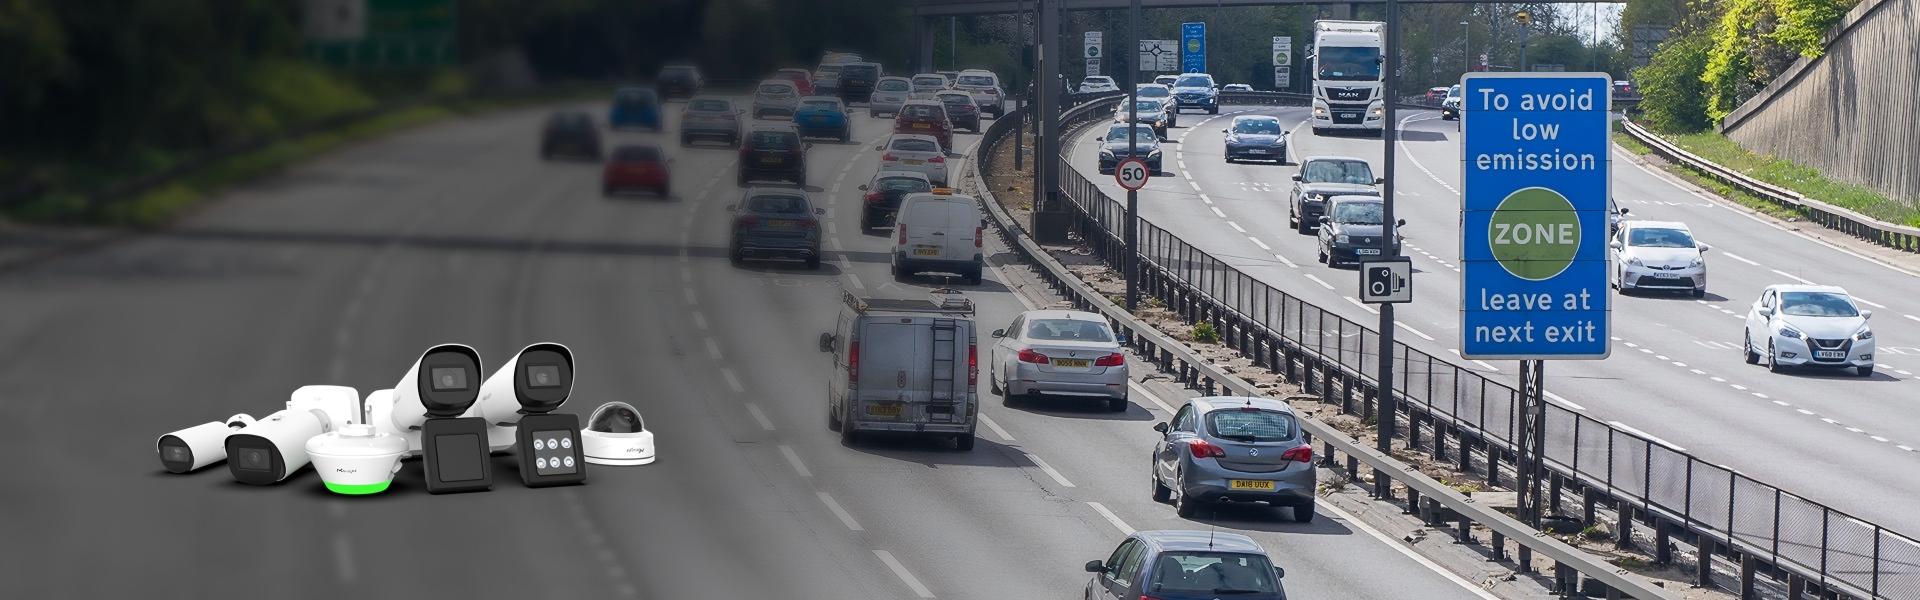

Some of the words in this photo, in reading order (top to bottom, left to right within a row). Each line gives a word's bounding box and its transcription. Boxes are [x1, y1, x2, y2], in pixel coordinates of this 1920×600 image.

[1478, 88, 1509, 111] To
[1520, 88, 1593, 111] avoid
[1513, 118, 1560, 141] low
[1476, 148, 1595, 171] emission
[1122, 167, 1144, 181] 50
[1494, 223, 1574, 245] ZONE
[1481, 288, 1553, 311] leave
[1563, 288, 1591, 311] at
[1475, 322, 1535, 343] next
[1545, 320, 1596, 343] exit
